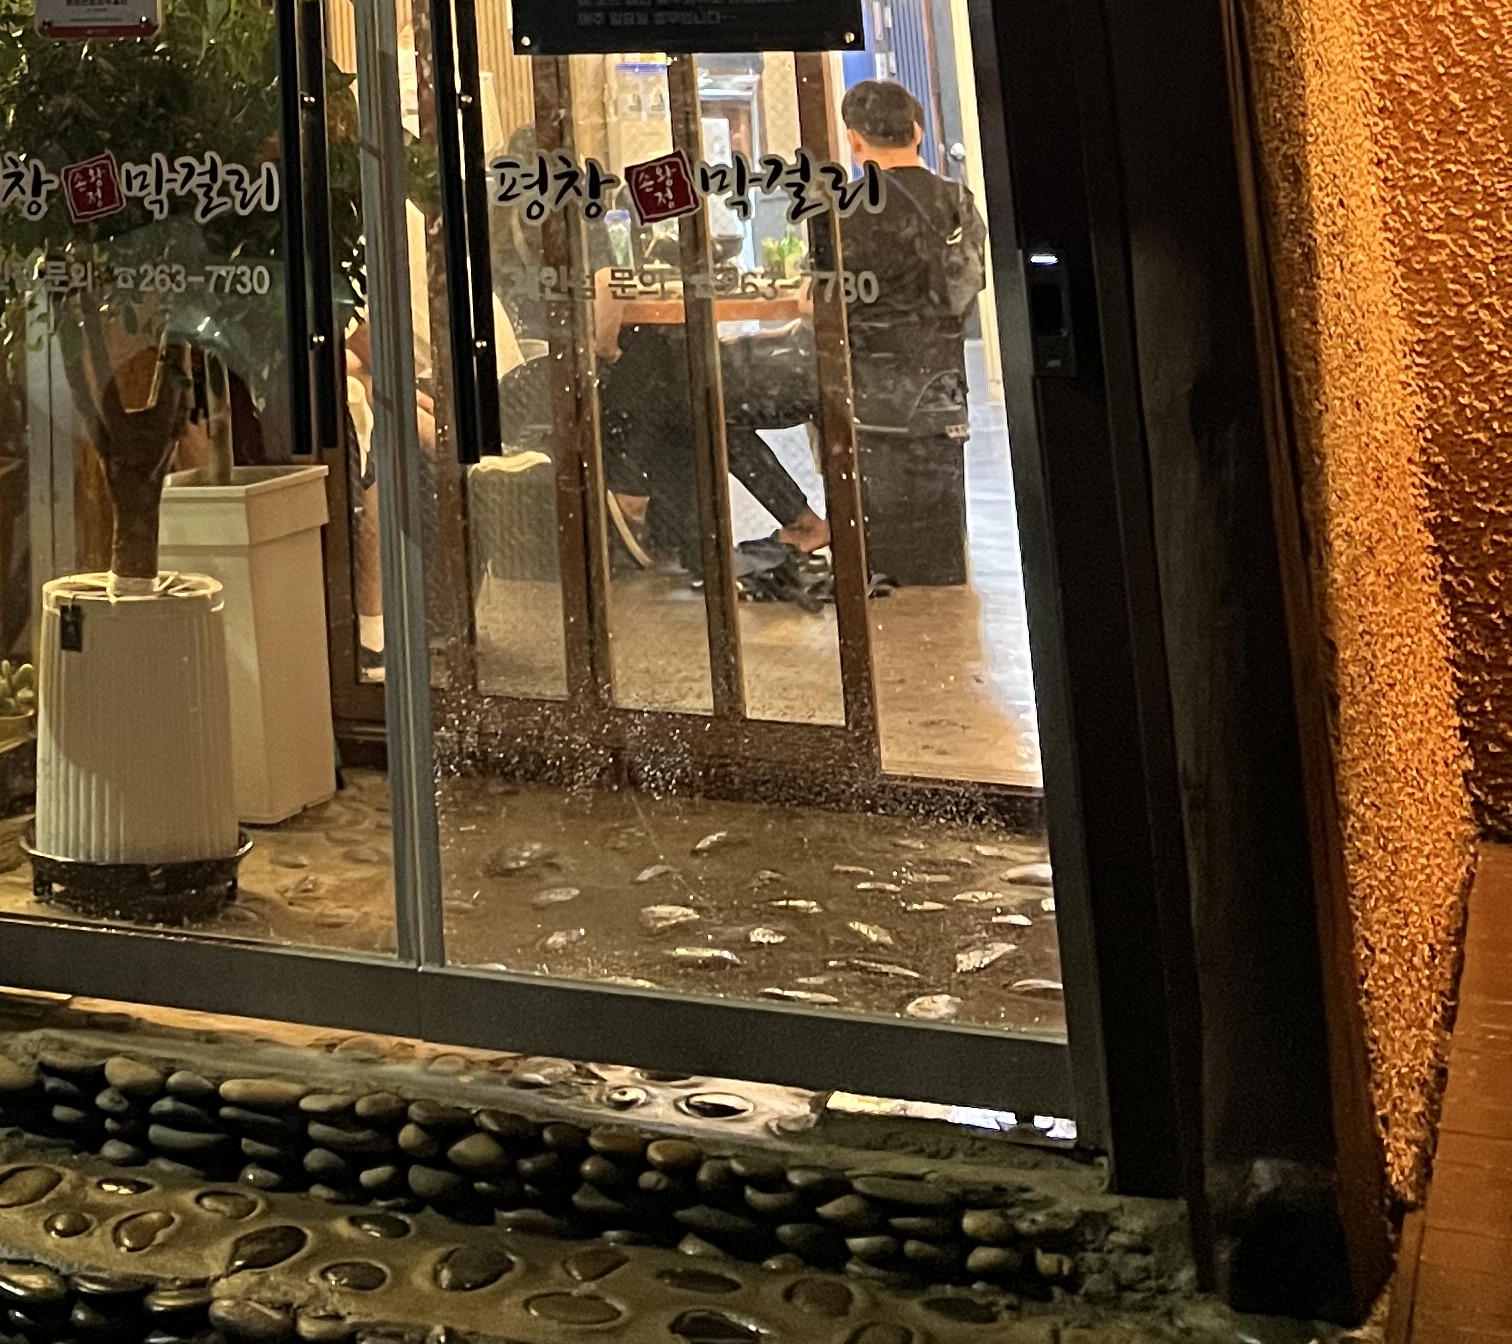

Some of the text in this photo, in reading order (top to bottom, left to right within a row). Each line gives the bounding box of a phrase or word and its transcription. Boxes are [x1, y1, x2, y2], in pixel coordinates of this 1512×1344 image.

[123, 152, 279, 221] 막걸리
[491, 155, 618, 222] 평창
[697, 149, 885, 223] 막걸리
[138, 264, 271, 295] 263-7730
[608, 266, 666, 301] 문의
